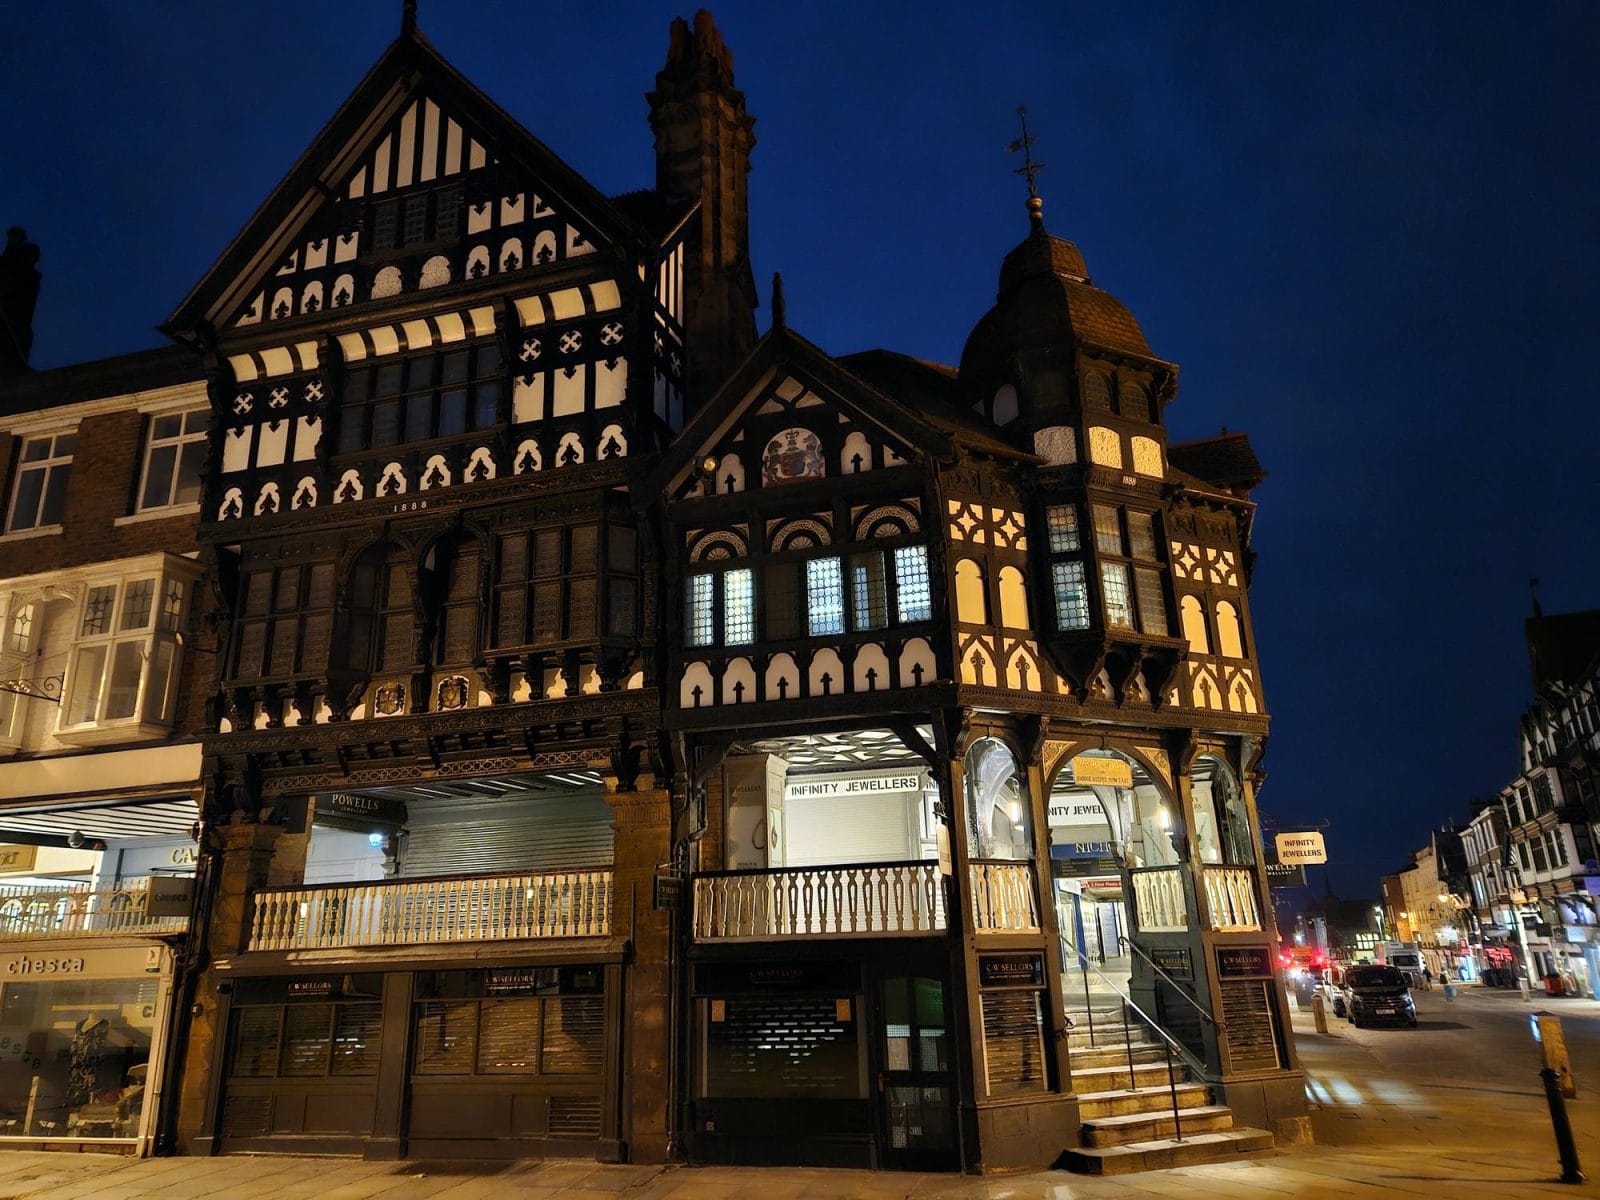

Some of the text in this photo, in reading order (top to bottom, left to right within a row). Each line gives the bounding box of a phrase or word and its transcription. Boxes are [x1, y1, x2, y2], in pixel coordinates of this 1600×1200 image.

[394, 500, 427, 512] 1888
[791, 783, 839, 796] INFINITY
[845, 776, 917, 792] JEWELLERS
[332, 793, 379, 810] POWELLS
[1048, 805, 1104, 816] NITY JEWEL
[1284, 839, 1315, 847] INFINITY
[1282, 849, 1322, 858] JEWELLERS
[8, 955, 85, 975] chesca
